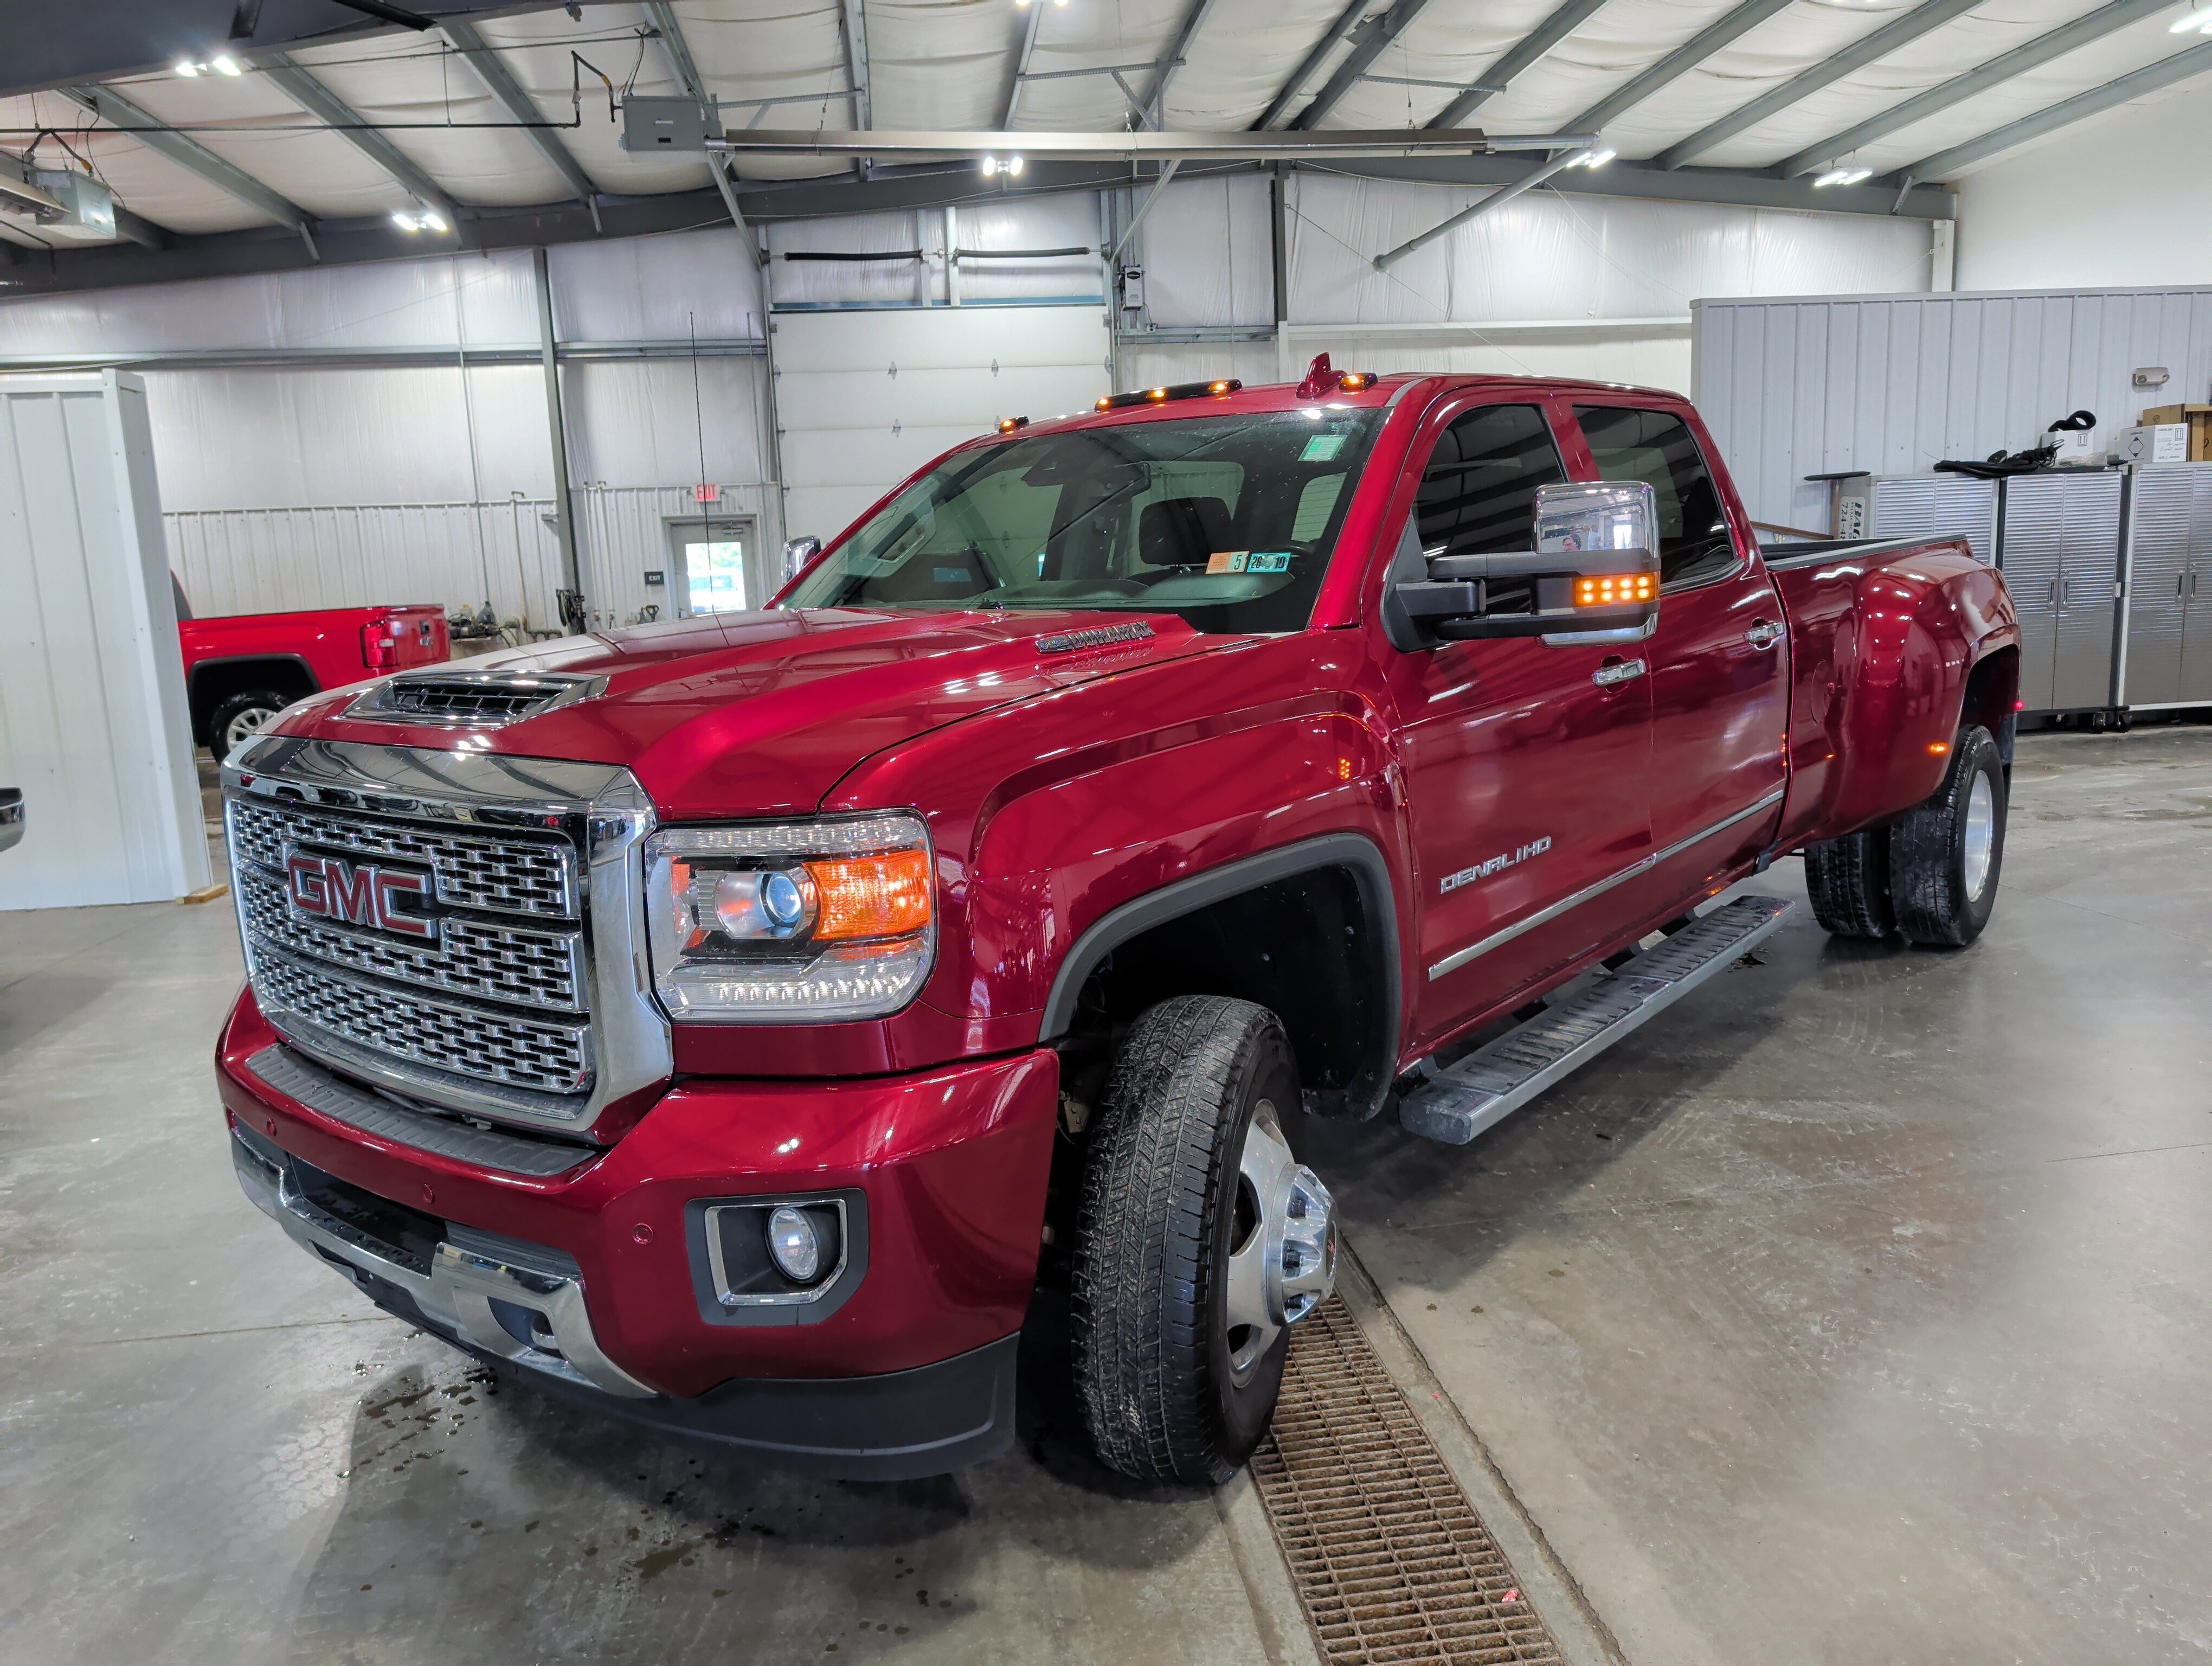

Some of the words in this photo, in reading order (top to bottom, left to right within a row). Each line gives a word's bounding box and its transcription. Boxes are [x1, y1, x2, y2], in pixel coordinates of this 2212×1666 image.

[696, 484, 717, 501] EXIT
[1234, 554, 1243, 570] 5
[1251, 556, 1262, 569] 26
[1067, 620, 1157, 648] DURAMAX
[288, 854, 434, 939] GMC
